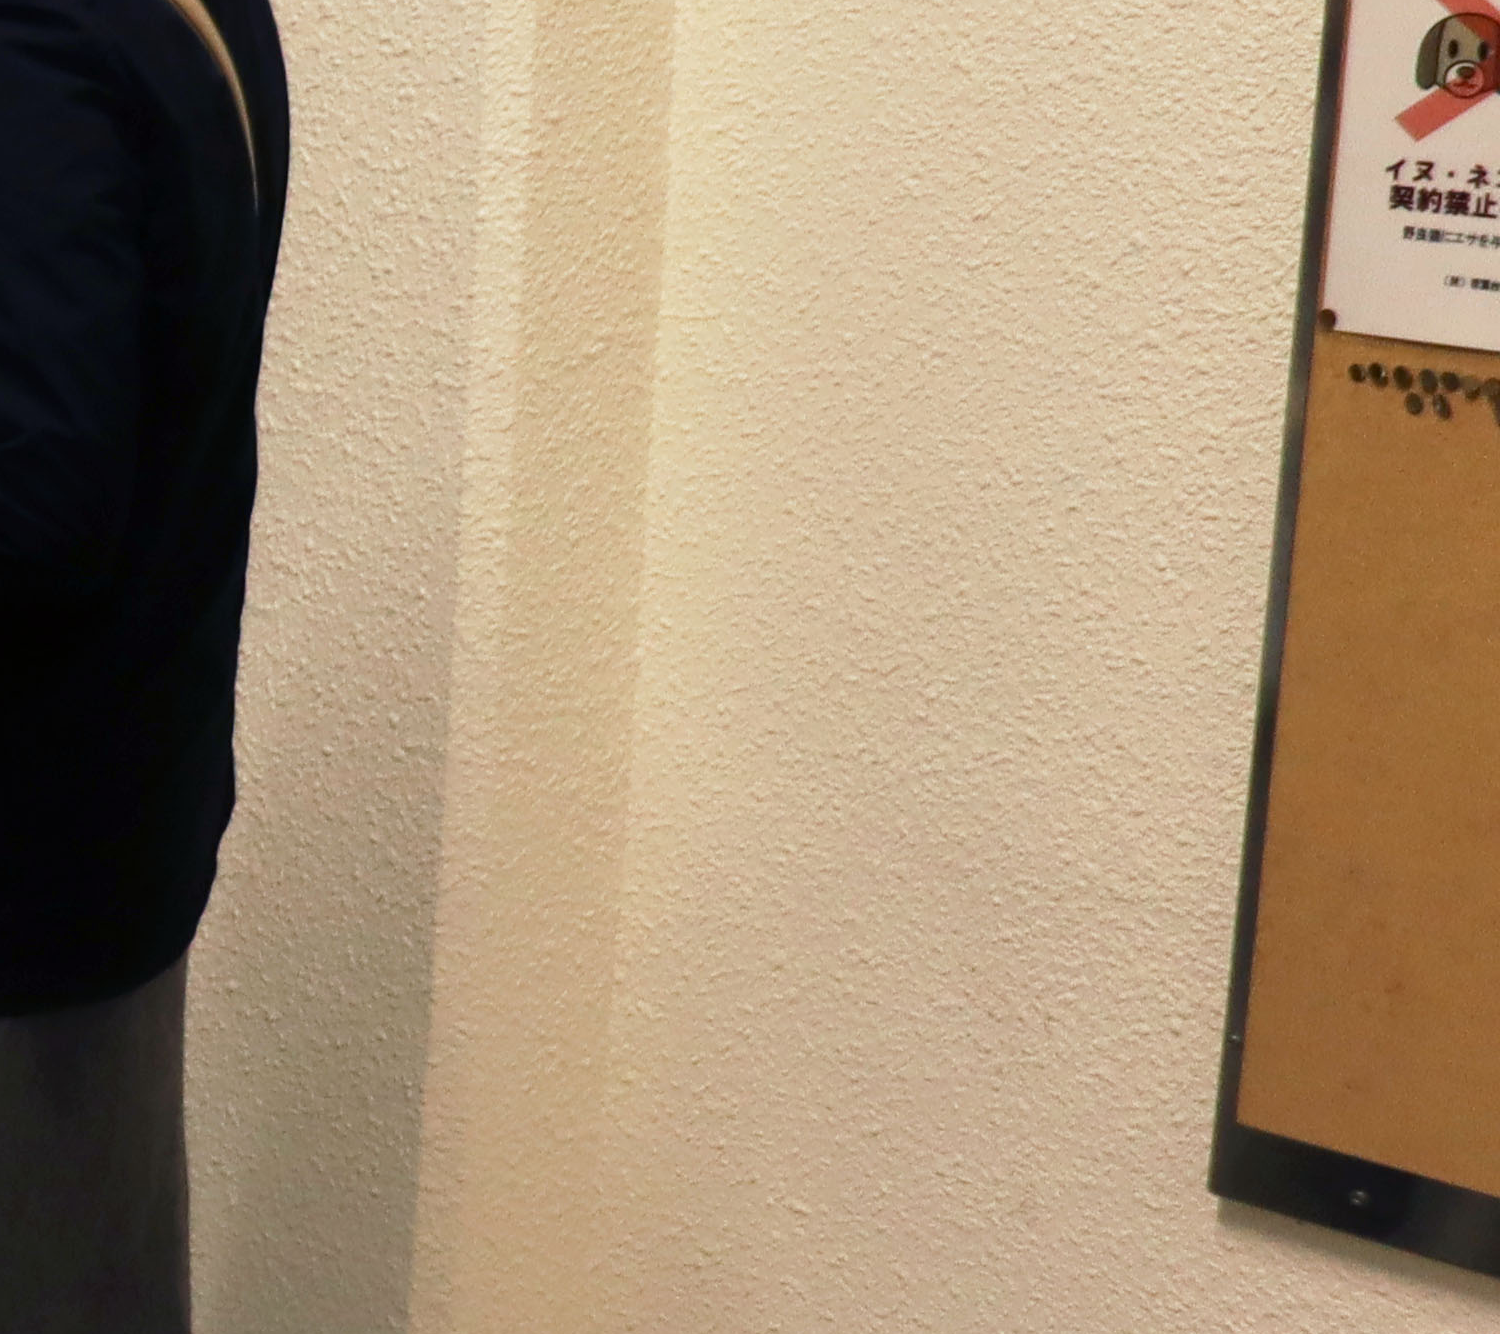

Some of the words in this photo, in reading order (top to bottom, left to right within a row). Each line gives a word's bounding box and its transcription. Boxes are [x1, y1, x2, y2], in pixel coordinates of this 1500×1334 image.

[1385, 158, 1500, 189] イヌ・ネ
[1388, 183, 1499, 220] 契約禁止
